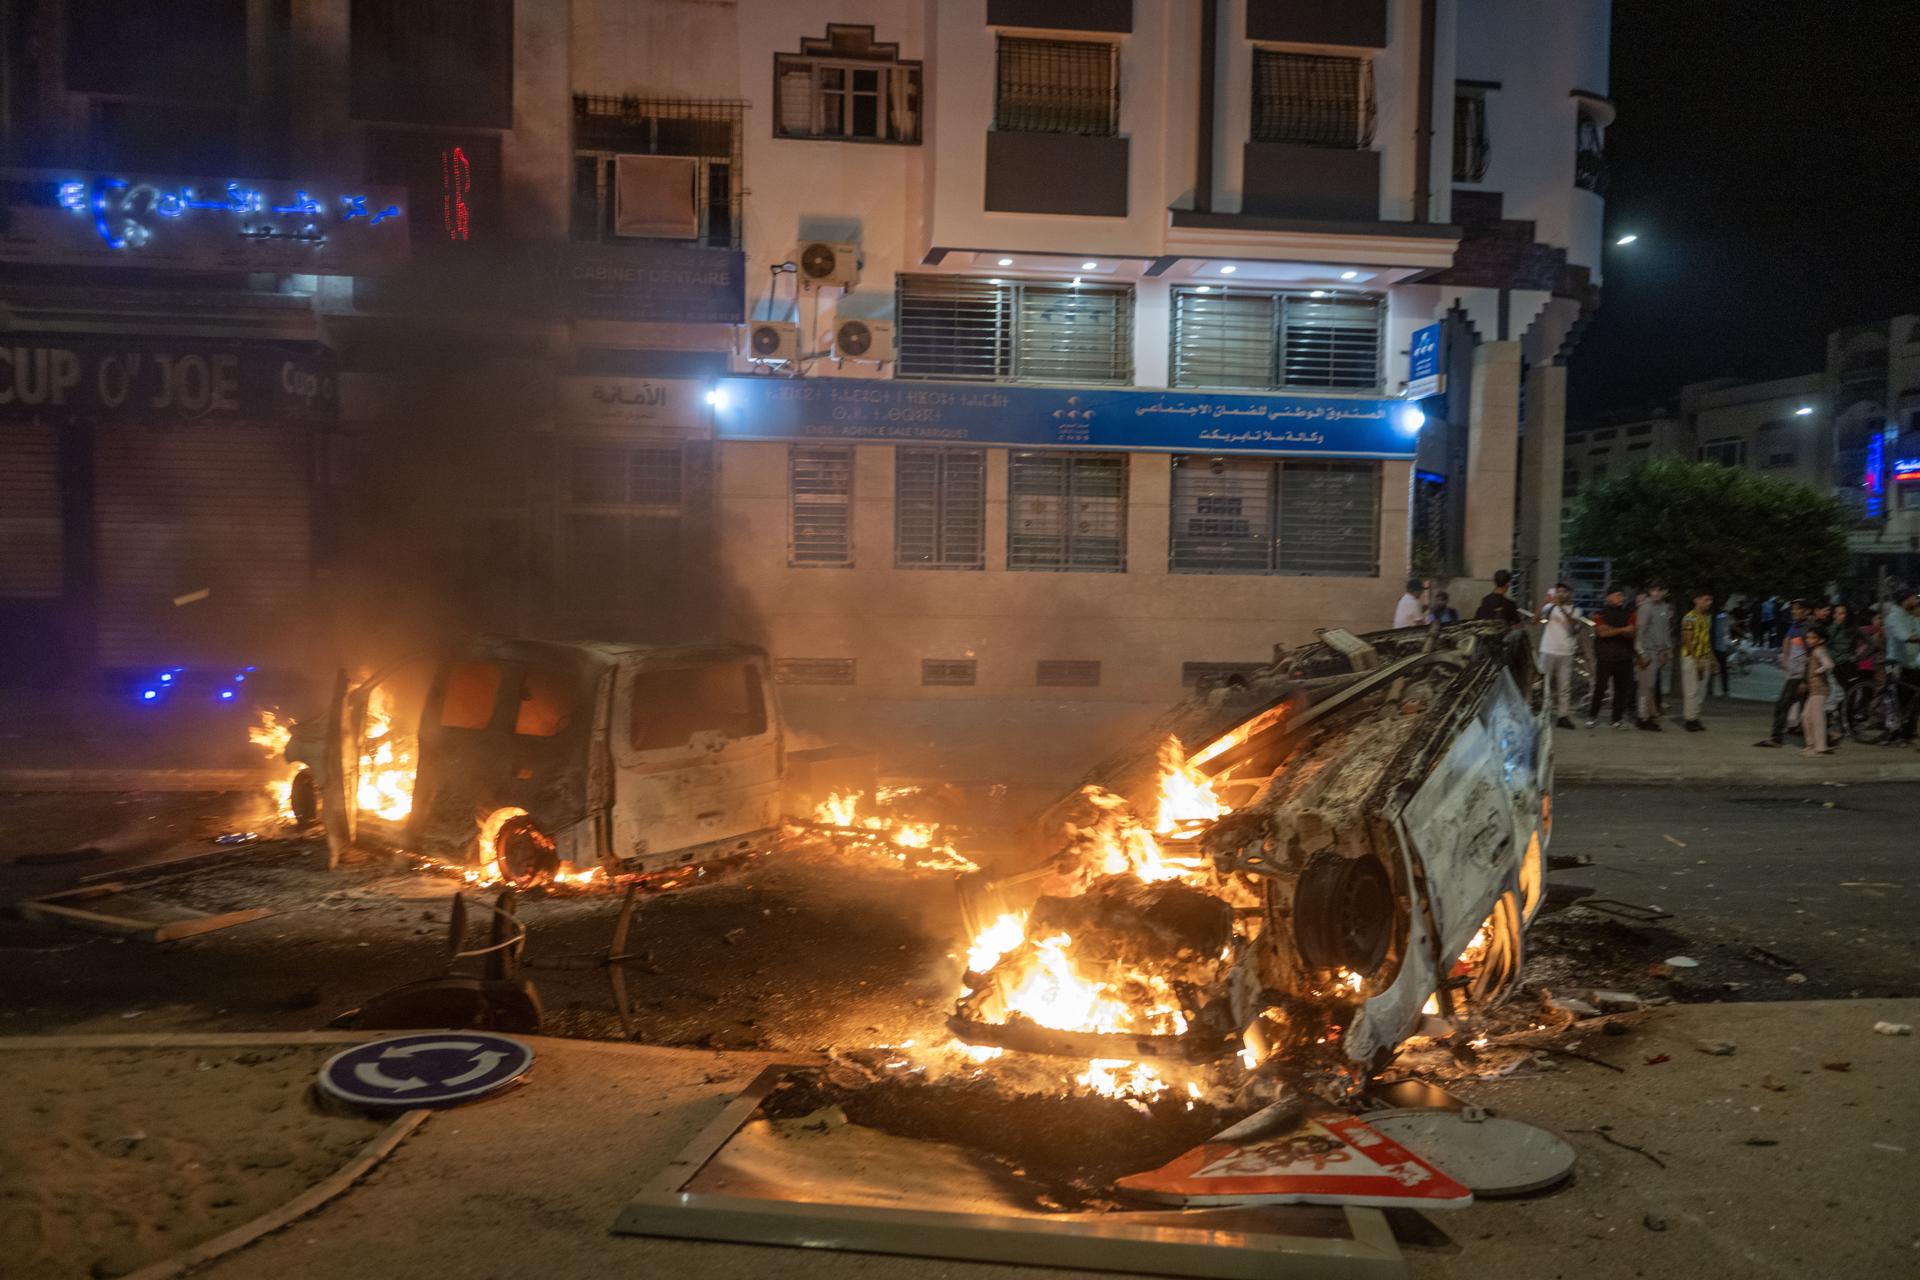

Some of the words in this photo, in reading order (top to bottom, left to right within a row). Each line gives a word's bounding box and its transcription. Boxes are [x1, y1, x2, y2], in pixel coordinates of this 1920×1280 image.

[648, 269, 730, 287] DENTAIRE
[150, 353, 240, 411] JOE
[592, 382, 666, 406] الأمانة
[1136, 395, 1212, 417] الاجتماعي
[1212, 403, 1268, 417] للضمان
[1267, 405, 1325, 421] الوطني
[842, 425, 886, 436] AGENCE
[1199, 428, 1262, 443] تابريكت
[1263, 430, 1285, 442] سلا
[1286, 430, 1325, 444] وكالة
